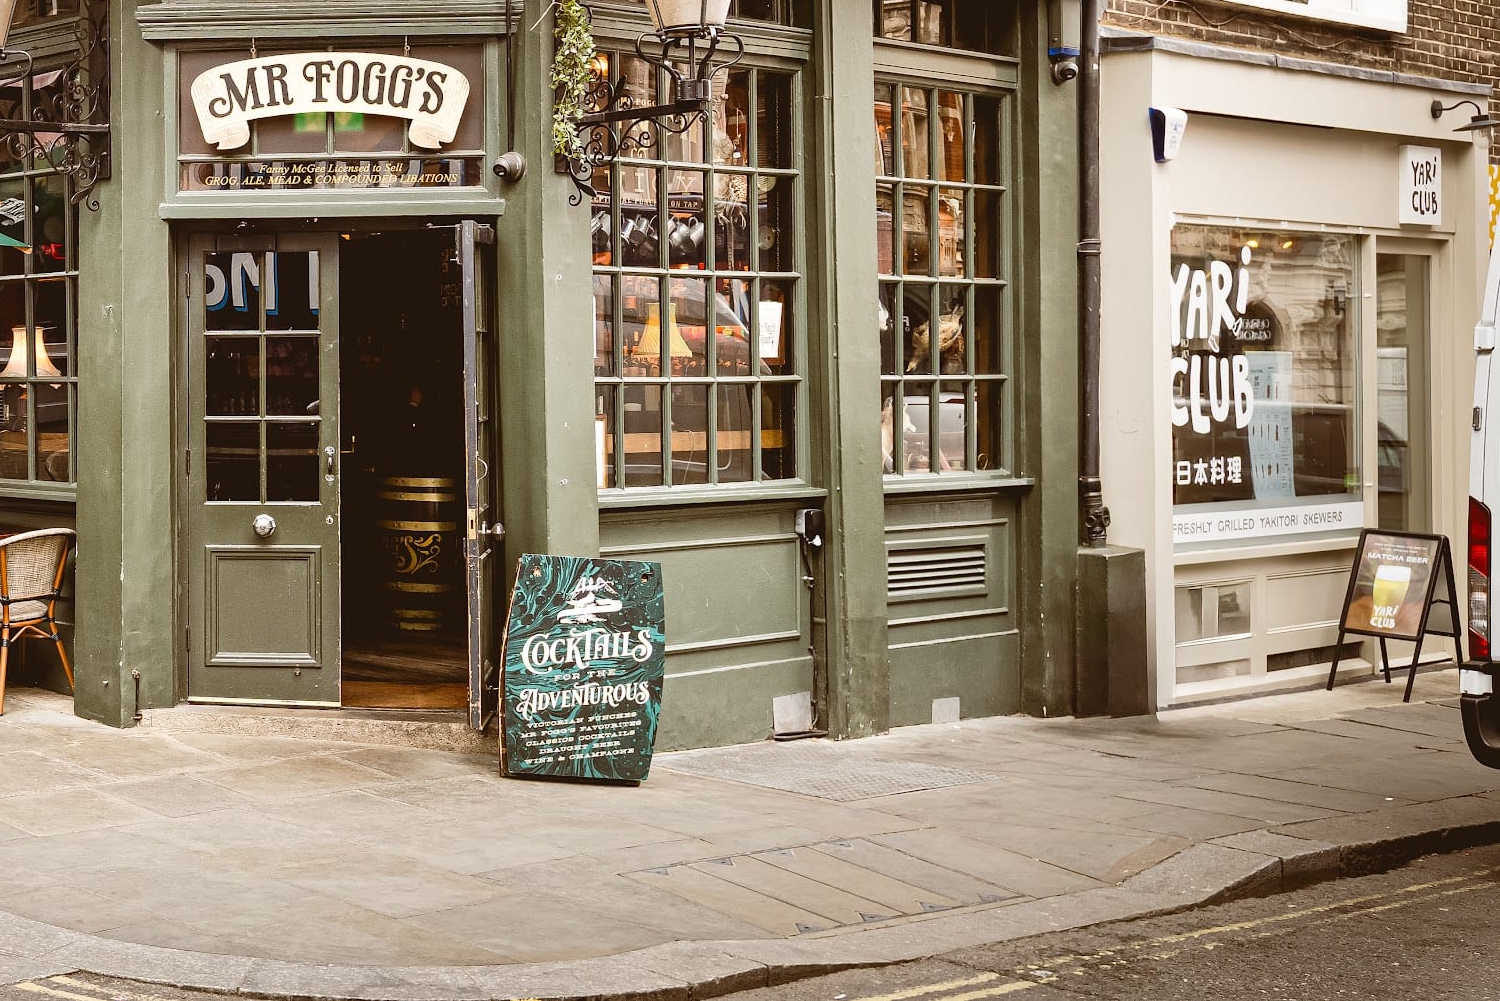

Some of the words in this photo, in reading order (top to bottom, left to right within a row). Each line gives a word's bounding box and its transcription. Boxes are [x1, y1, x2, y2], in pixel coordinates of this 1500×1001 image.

[208, 62, 294, 118] MR
[303, 59, 448, 115] FOGG'S
[259, 164, 290, 175] Fanny
[291, 164, 326, 174] McGee
[328, 163, 370, 174] Licensed
[372, 164, 382, 173] to
[385, 162, 404, 173] Sell
[268, 176, 301, 185] MEAD
[303, 175, 313, 185] &
[315, 175, 398, 185] COMPOUNDED
[400, 173, 459, 184] LIBATIONS
[1412, 190, 1438, 215] CLUB
[1171, 354, 1254, 435] CLUB
[1176, 455, 1242, 486] 日本料理
[1172, 520, 1213, 536] FRESHLY
[1218, 518, 1255, 532] GRILLED
[1260, 514, 1299, 529] YAKITORI
[1303, 511, 1343, 525] SKEWERS
[1367, 552, 1404, 562] MATCHA
[1406, 556, 1429, 564] BEER
[1370, 617, 1396, 629] CLUB
[520, 627, 653, 675] COCKTAILS
[554, 672, 581, 682] FOR
[587, 668, 618, 678] THE
[516, 681, 651, 721] ADVENTUROUS
[526, 717, 585, 729] VICTORIAN
[587, 711, 638, 722] PUNCHES
[520, 731, 537, 739] MR
[541, 727, 576, 737] FOGG'S
[579, 720, 642, 732] FAVOURITES
[525, 736, 575, 747] CLASSICS
[578, 729, 636, 741] COCKTAILS
[524, 756, 554, 765] WINE
[568, 747, 635, 760] CHAMPAGNE
[539, 744, 589, 755] DRAUGHT
[592, 740, 621, 749] BEER
